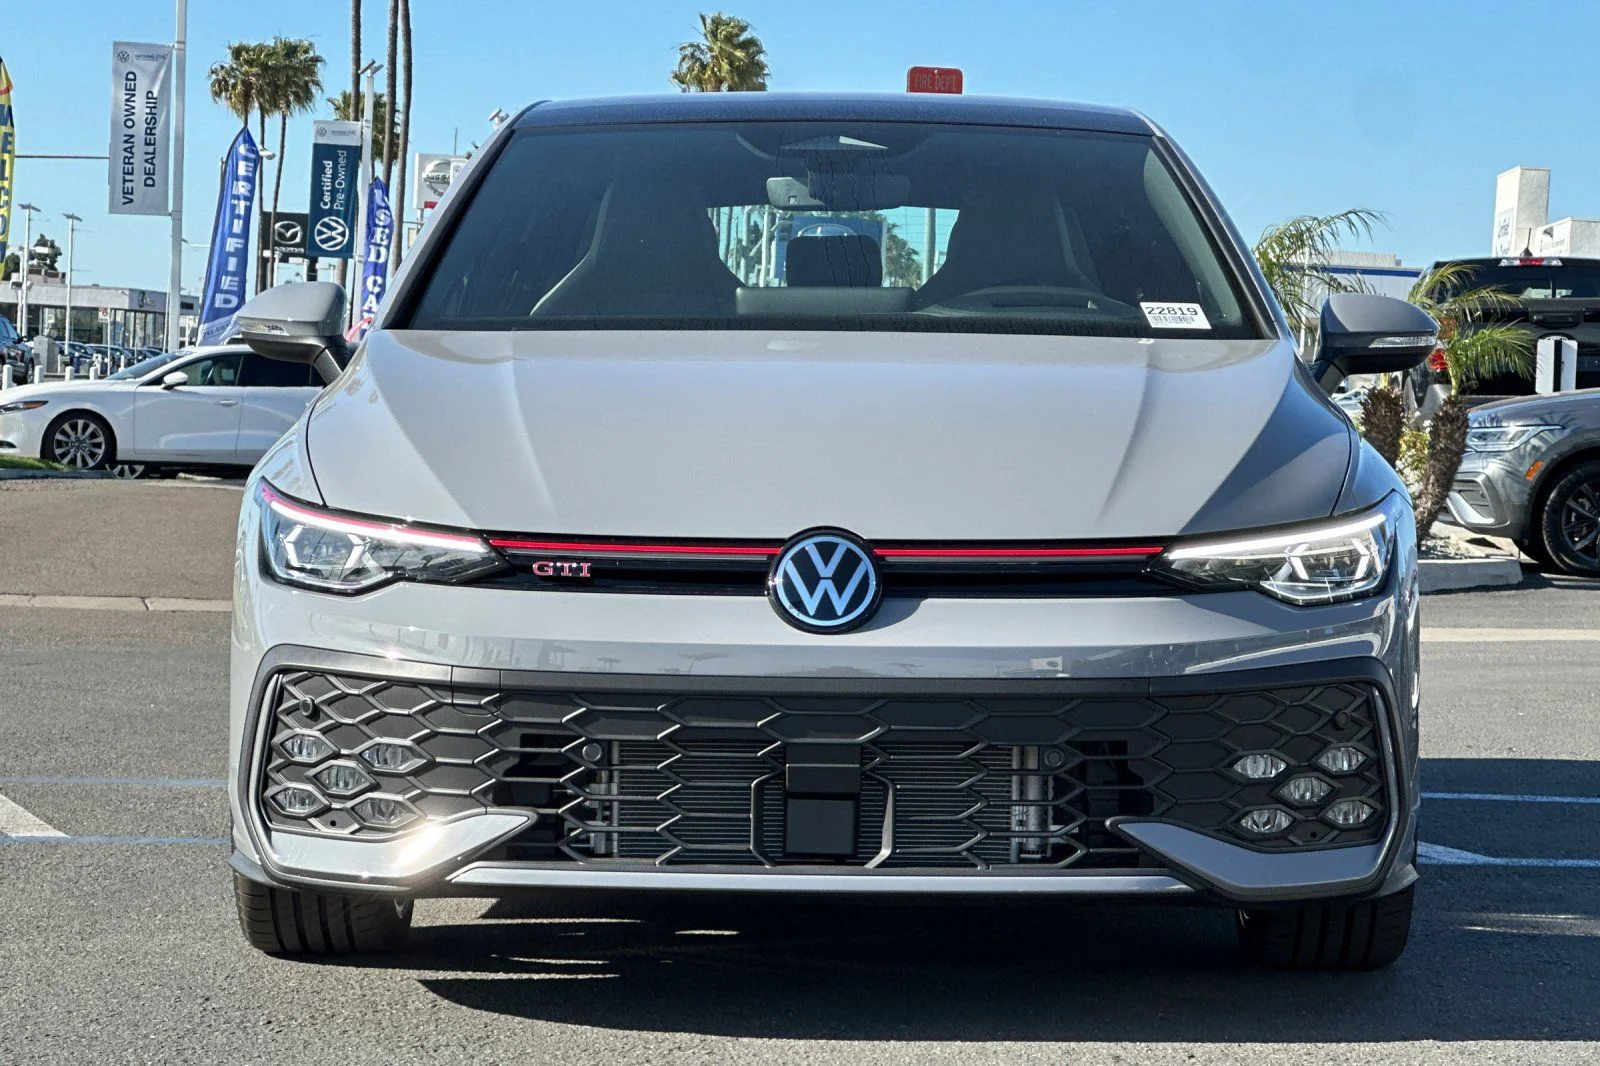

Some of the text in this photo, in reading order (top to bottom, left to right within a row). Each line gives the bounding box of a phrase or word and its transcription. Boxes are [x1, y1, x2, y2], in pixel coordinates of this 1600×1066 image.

[915, 73, 933, 89] FIRE
[122, 71, 137, 206] VETERAN OWNED
[144, 90, 158, 188] DEALERSHIP
[320, 160, 333, 210] Certified
[333, 150, 347, 210] Pre-Owned
[214, 143, 258, 308] CERTIFIED
[368, 188, 391, 263] USED
[1145, 306, 1198, 316] 22819
[532, 560, 593, 578] GTI
